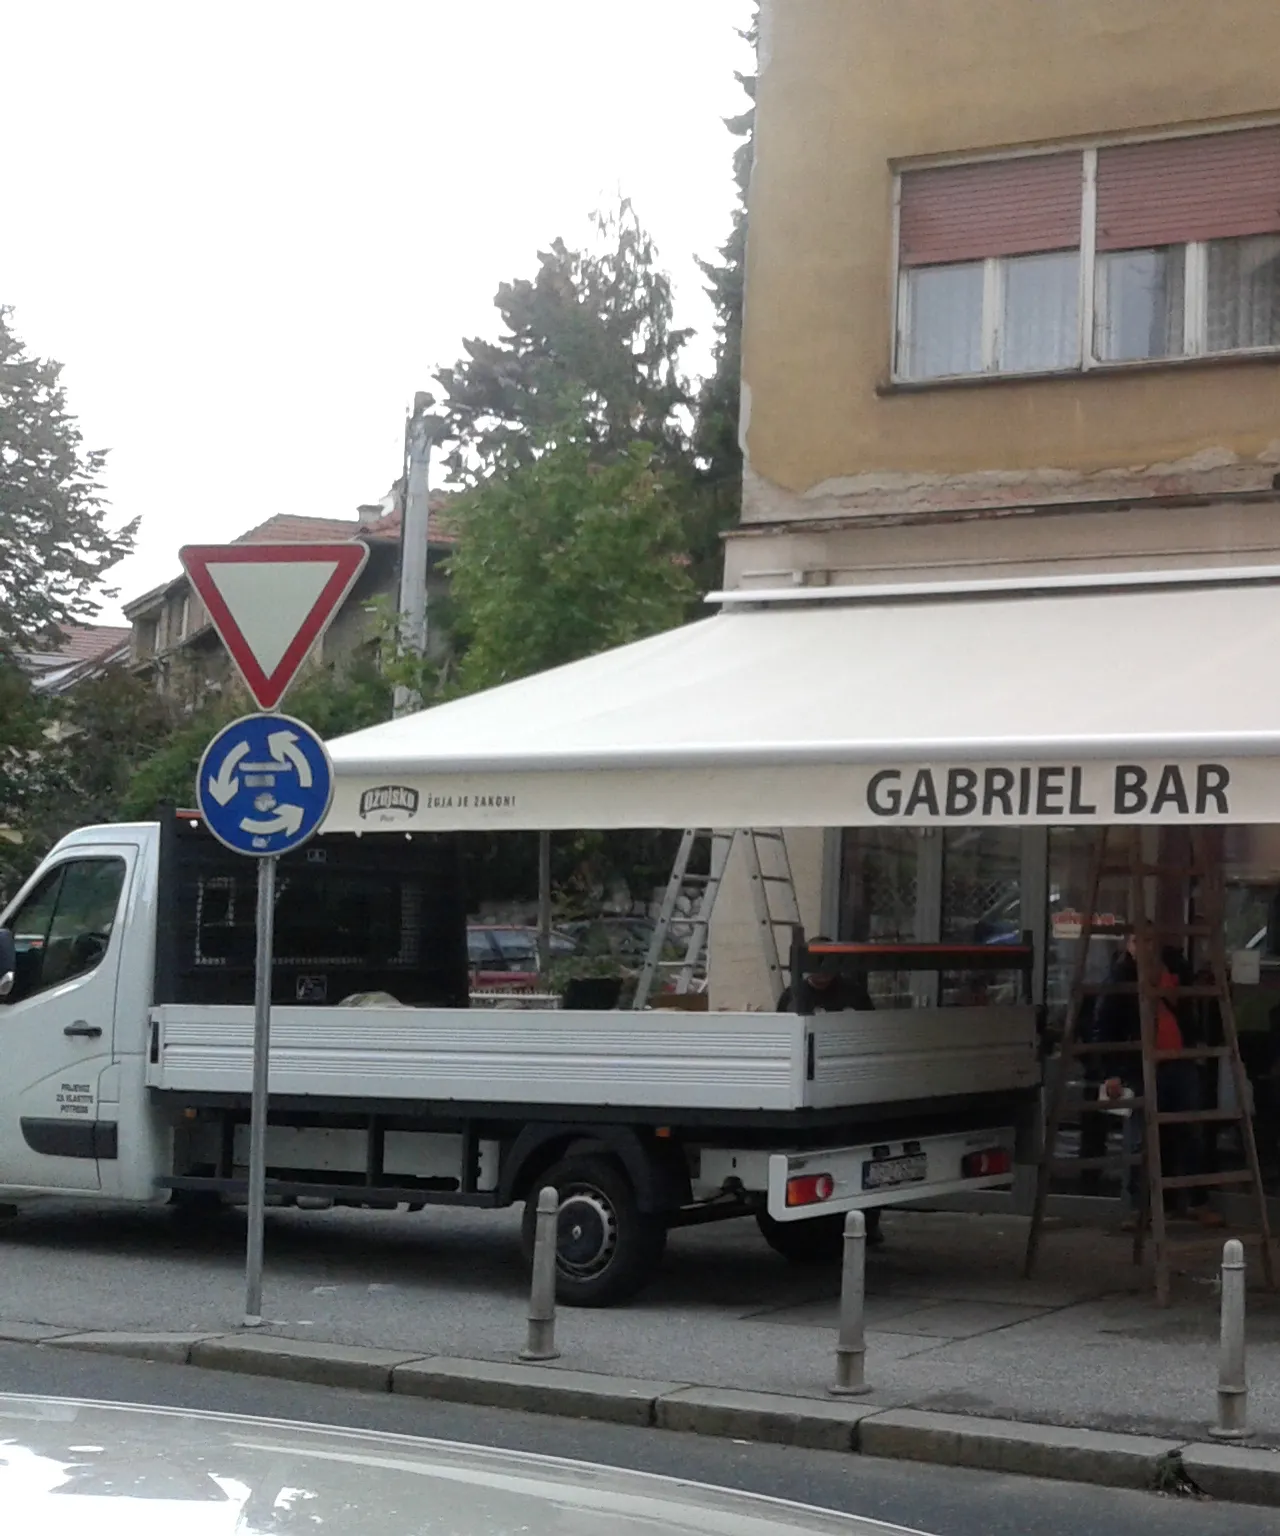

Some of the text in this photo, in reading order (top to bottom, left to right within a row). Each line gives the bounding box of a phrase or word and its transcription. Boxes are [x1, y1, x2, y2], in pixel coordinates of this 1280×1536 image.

[457, 796, 469, 808] JE
[866, 764, 1231, 816] GABRIEL BAR
